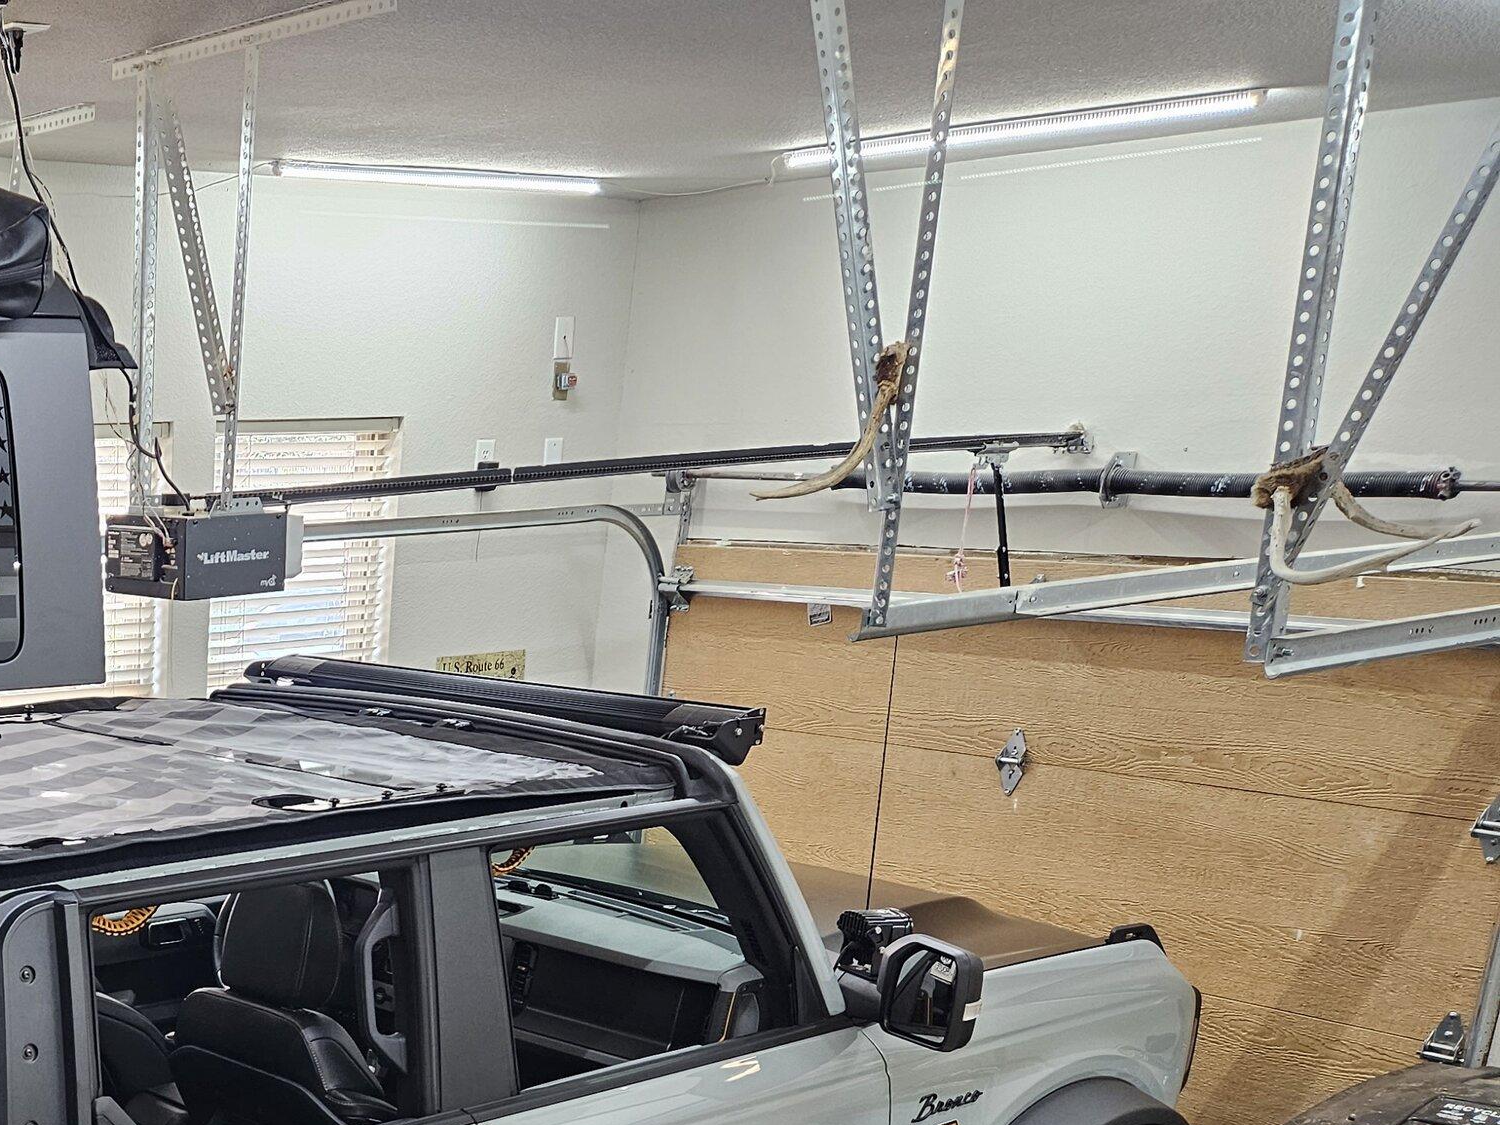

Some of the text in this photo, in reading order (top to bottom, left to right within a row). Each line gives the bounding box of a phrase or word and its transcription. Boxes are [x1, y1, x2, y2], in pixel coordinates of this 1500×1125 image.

[202, 548, 269, 565] LiftMaster
[442, 658, 505, 674] US. Route 66
[910, 1089, 984, 1124] Bronco
